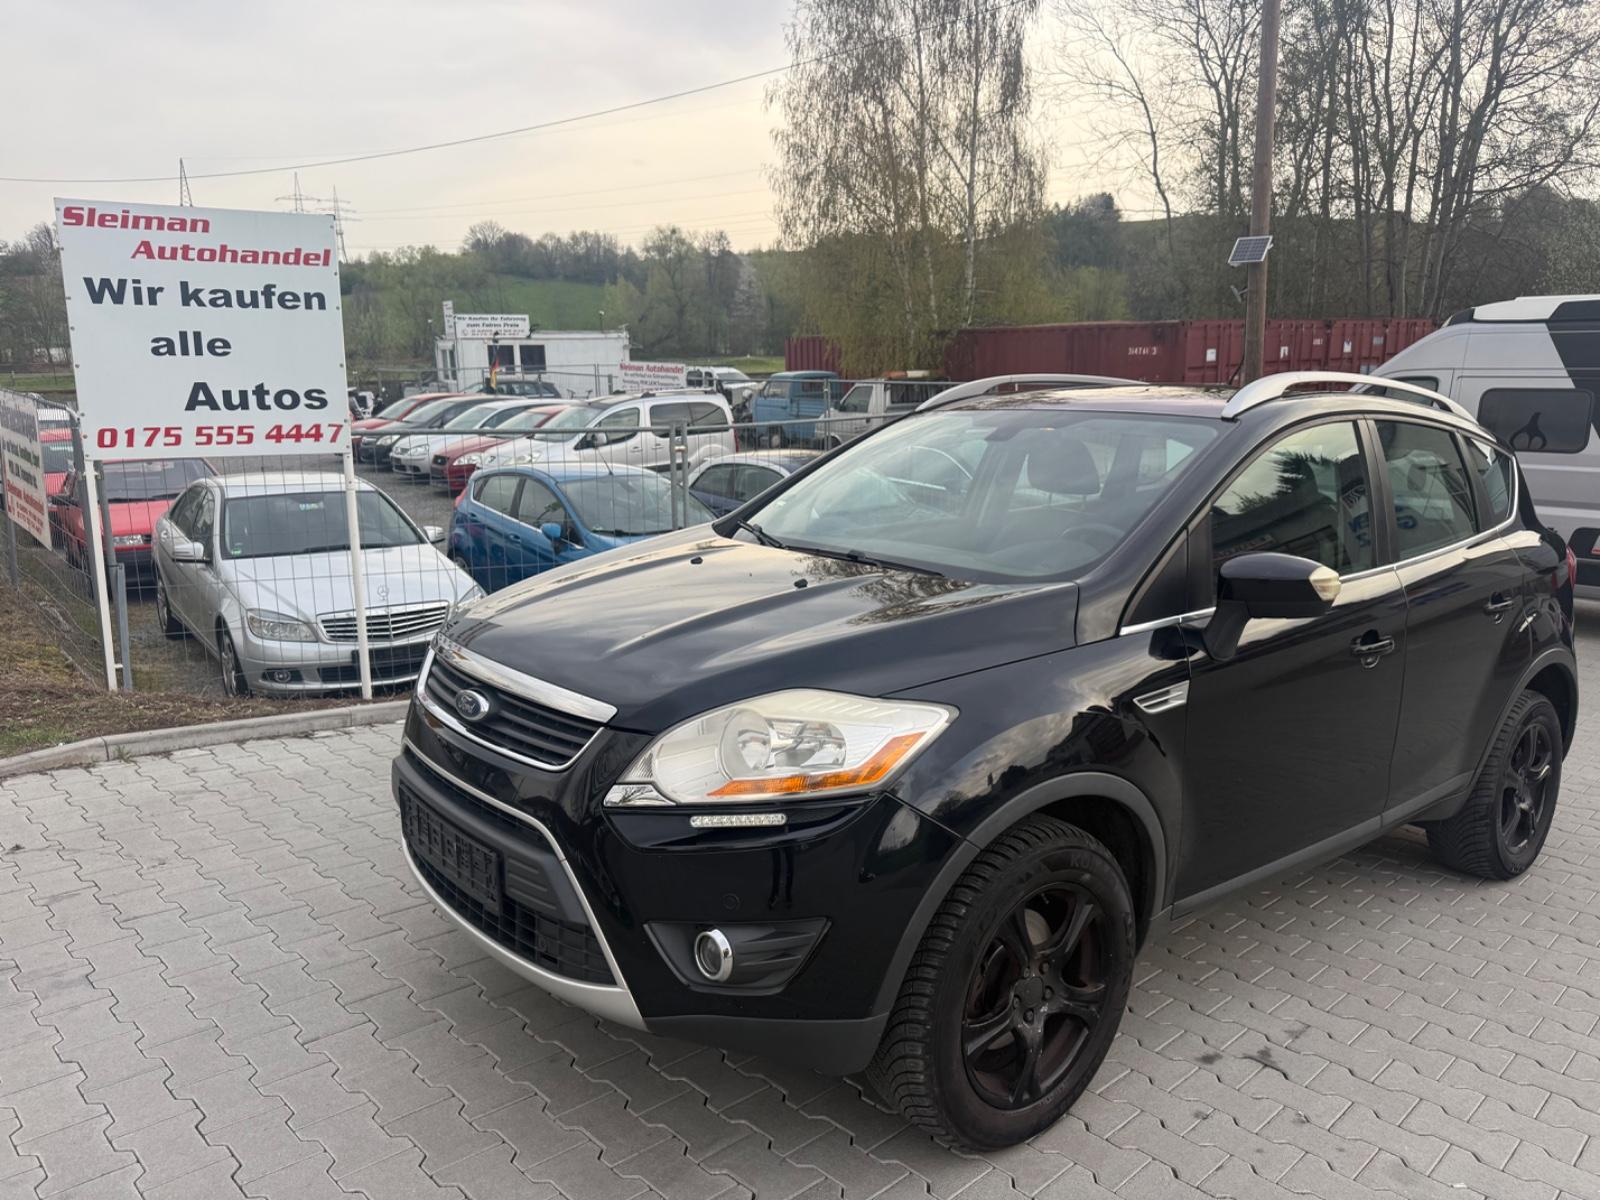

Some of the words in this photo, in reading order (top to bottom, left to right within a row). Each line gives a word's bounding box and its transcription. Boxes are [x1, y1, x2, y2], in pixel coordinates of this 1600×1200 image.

[63, 206, 210, 233] Sleiman
[131, 239, 331, 266] Autohandel
[82, 276, 165, 306] Wir
[179, 280, 327, 311] kaufen
[150, 330, 232, 357] alle
[184, 381, 329, 412] Autos
[97, 426, 183, 449] 0175
[195, 425, 255, 447] 555
[265, 423, 344, 444] 4447
